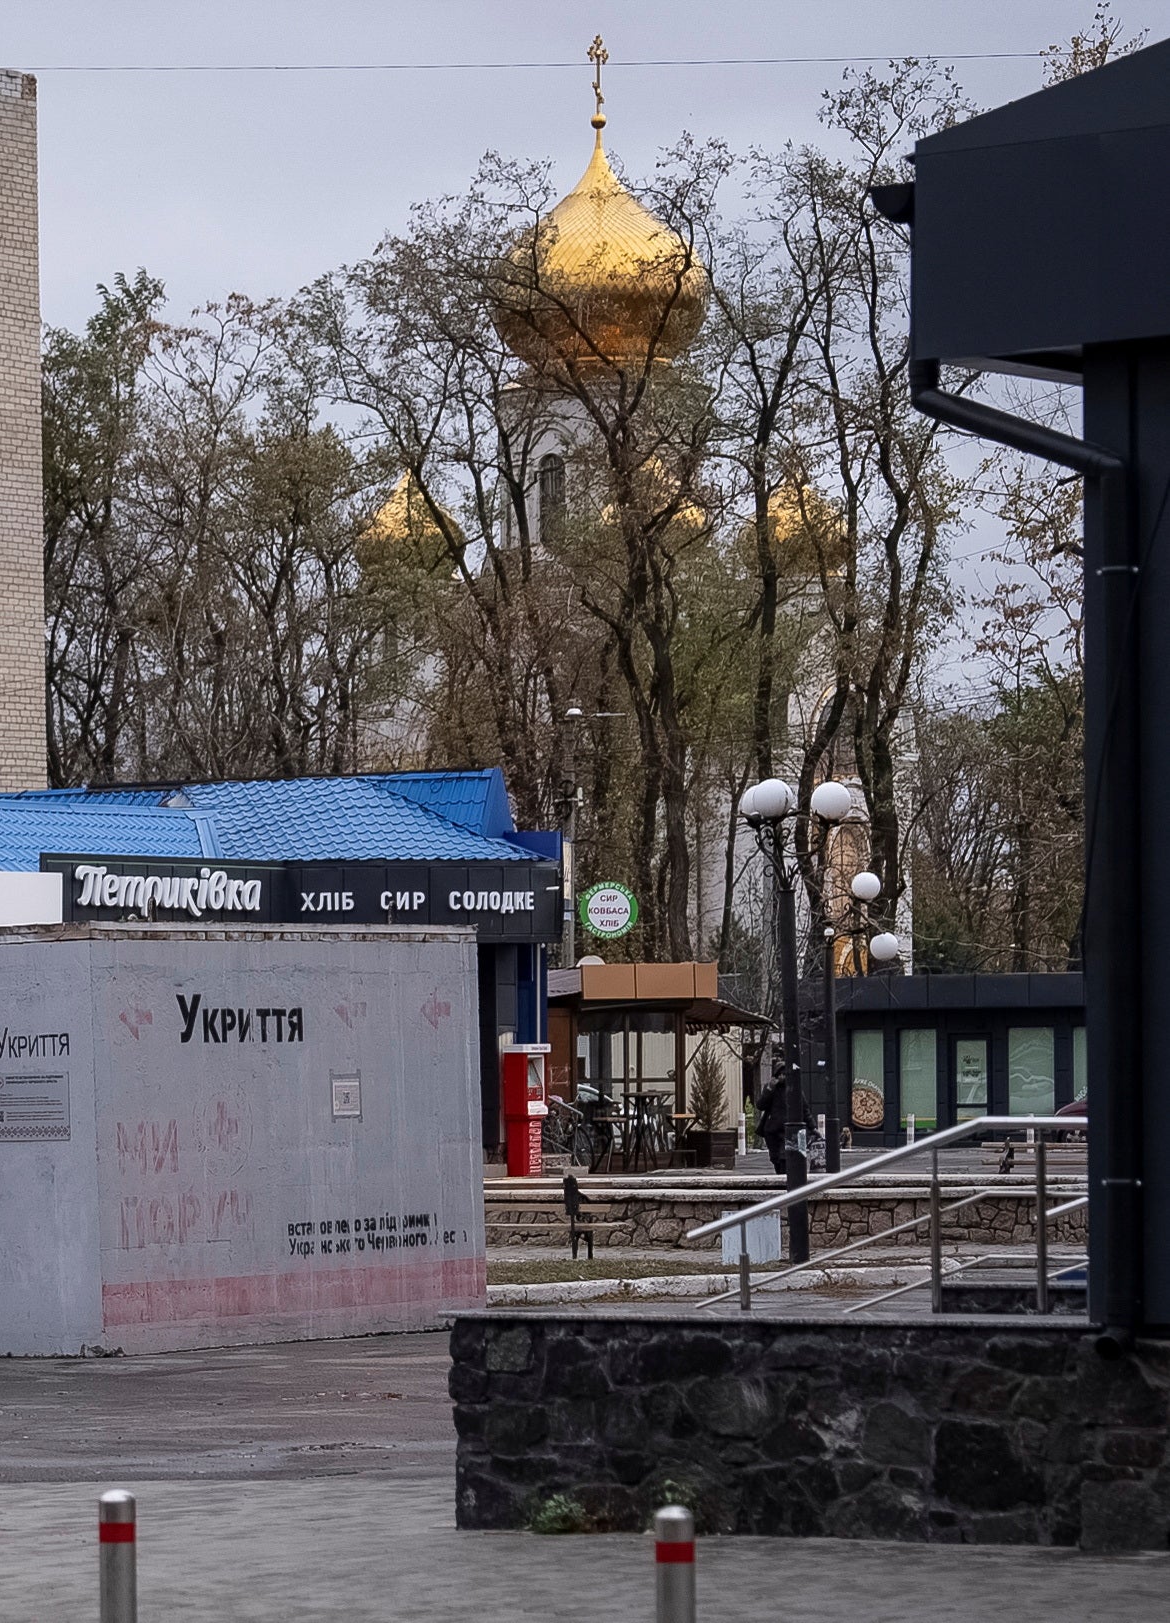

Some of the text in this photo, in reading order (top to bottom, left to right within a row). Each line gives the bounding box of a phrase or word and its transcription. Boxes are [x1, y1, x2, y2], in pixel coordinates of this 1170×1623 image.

[75, 865, 262, 917] Петриківка
[585, 882, 633, 900] ФЕРМЕРСЬКА
[600, 894, 618, 902] СИР
[301, 891, 535, 914] ХЛІБ СИР СОЛОДКЕ
[588, 907, 629, 915] КОВБАСА
[584, 921, 634, 939] ГАСТРОНОМІЯ
[599, 919, 620, 927] ХЛІБ
[116, 1119, 179, 1175] МИ
[363, 1217, 377, 1231] за
